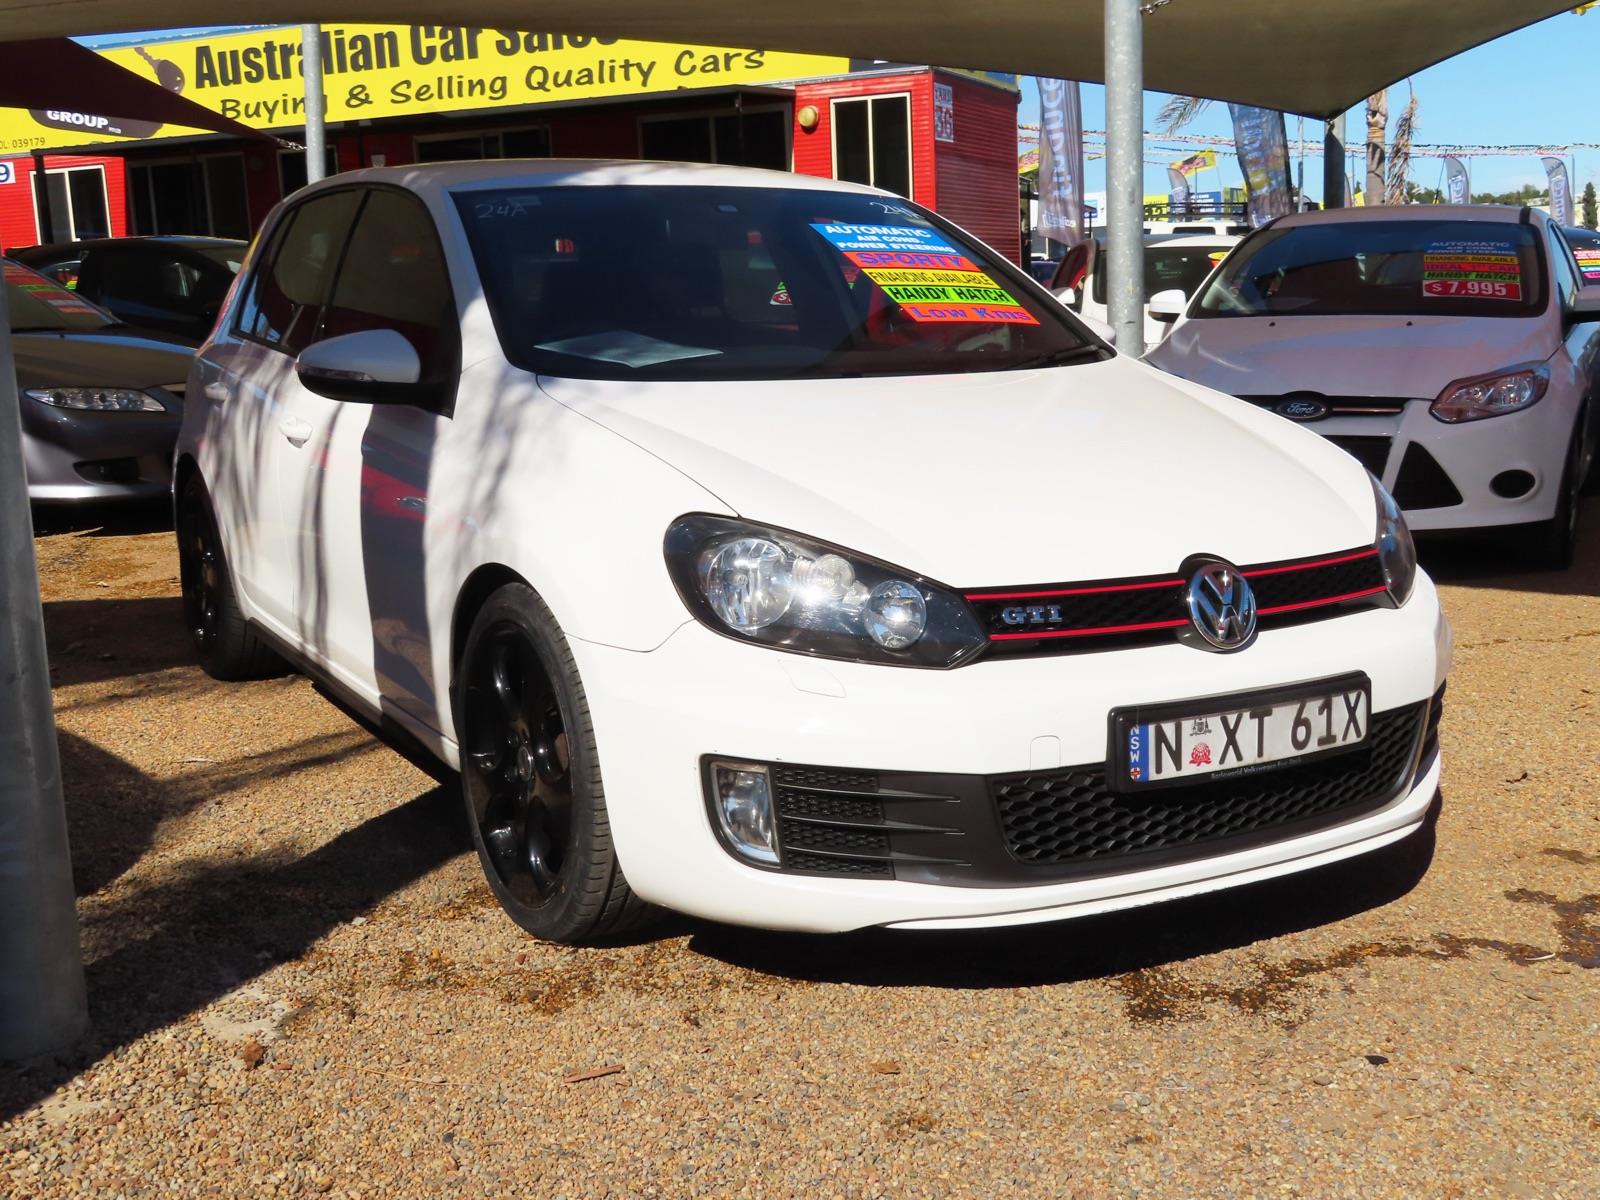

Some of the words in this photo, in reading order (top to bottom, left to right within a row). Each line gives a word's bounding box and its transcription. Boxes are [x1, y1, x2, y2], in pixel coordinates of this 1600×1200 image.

[410, 24, 483, 65] Car
[221, 93, 328, 123] Buyin
[345, 84, 373, 108] &
[390, 75, 507, 104] Selling
[525, 59, 656, 92] Quality
[674, 49, 765, 76] Cars
[46, 109, 108, 128] GROUP
[12, 137, 46, 149] 039179
[825, 225, 931, 238] AUTOMATIC
[889, 243, 957, 254] STEERING
[856, 253, 962, 267] SPORTY
[868, 271, 933, 283] FINANCING
[934, 273, 994, 286] AVAILABLE
[1426, 271, 1471, 279] HANDY
[1474, 272, 1518, 280] HATCH
[888, 287, 951, 300] HANDY
[952, 289, 1011, 302] HATCH
[1448, 281, 1507, 296] 7,995
[1287, 402, 1315, 414] Ford
[1001, 604, 1064, 625] GTI
[1154, 720, 1183, 775] N
[1290, 690, 1363, 751] 61X
